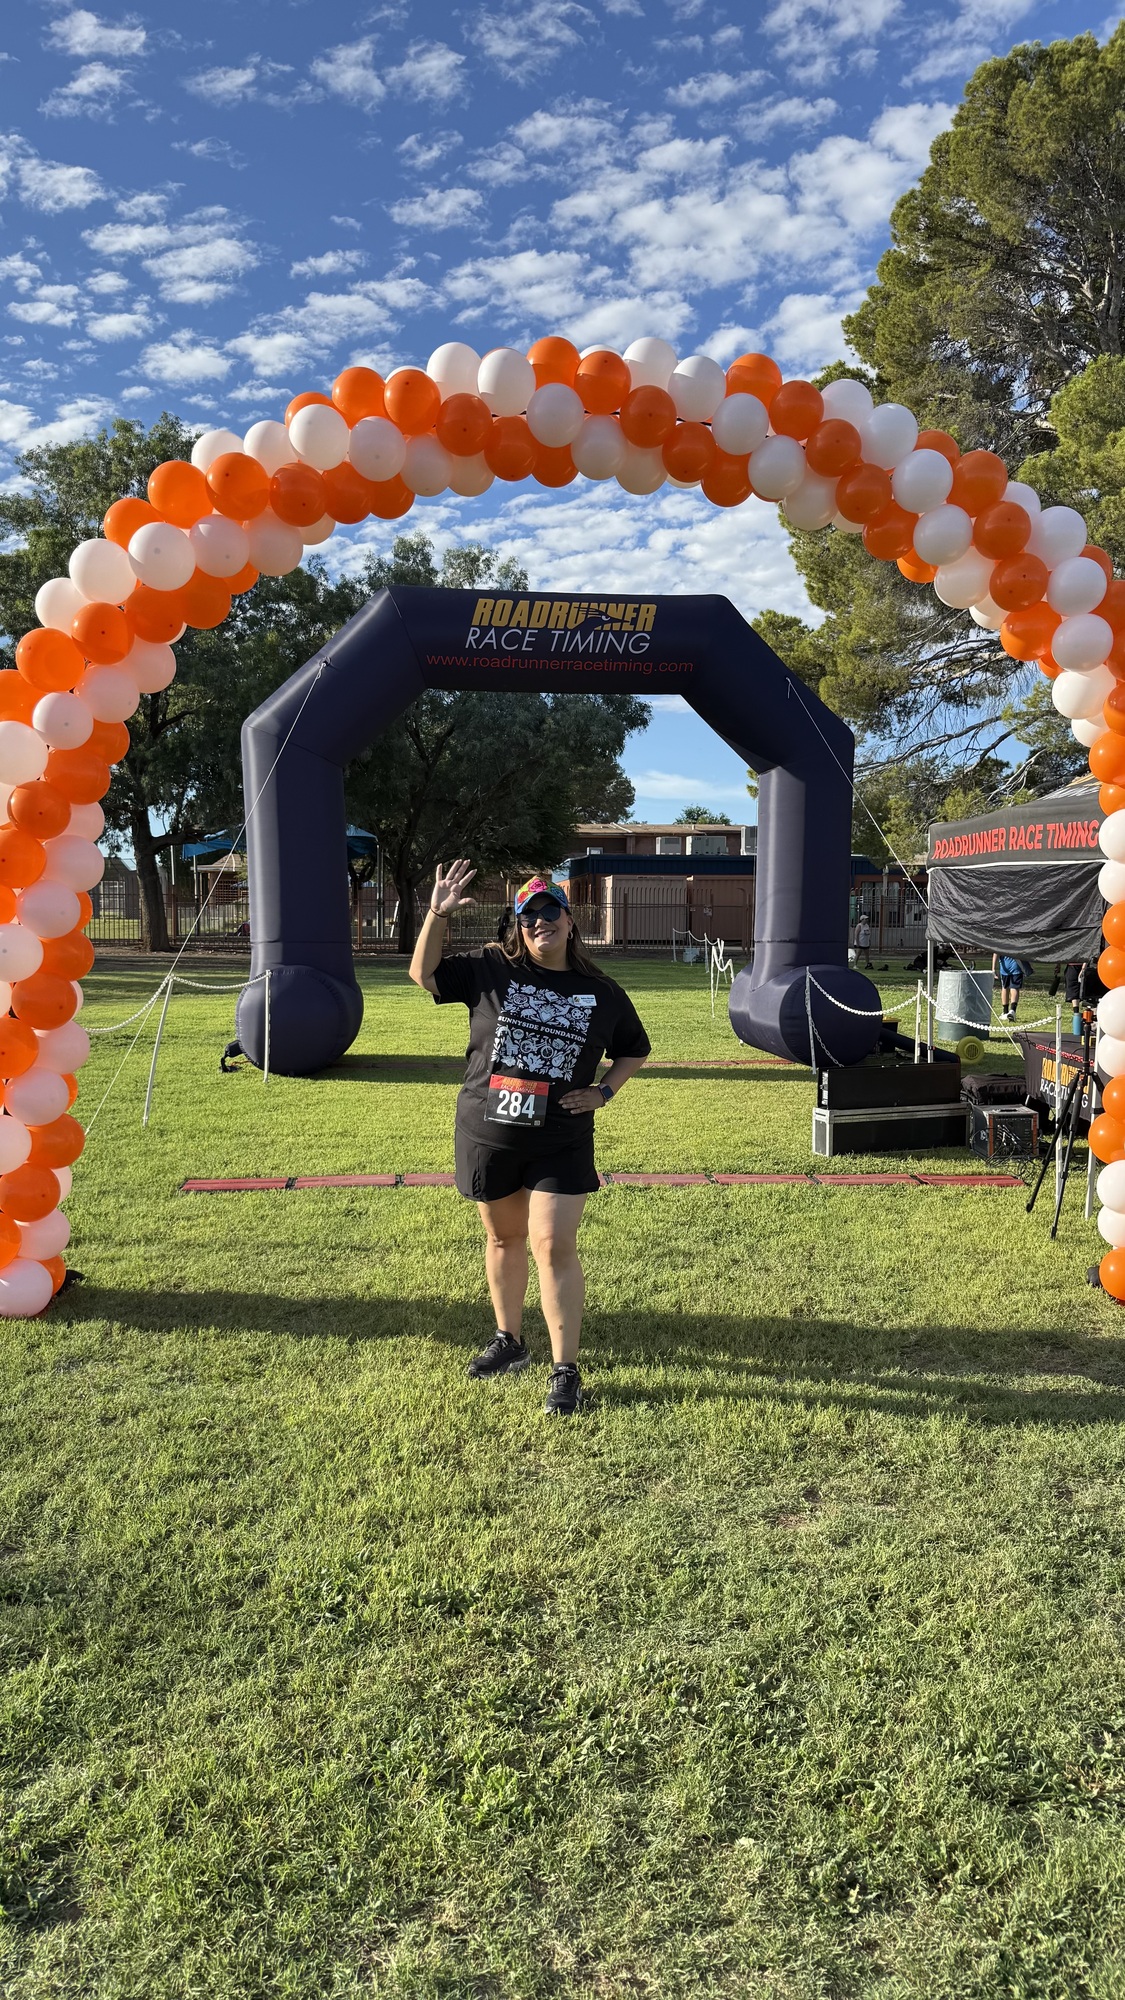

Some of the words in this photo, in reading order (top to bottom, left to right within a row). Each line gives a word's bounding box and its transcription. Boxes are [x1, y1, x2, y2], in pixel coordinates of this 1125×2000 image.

[471, 598, 657, 631] ROADRUNNER
[465, 627, 538, 651] RACE
[550, 631, 650, 654] TIMING
[426, 654, 694, 675] www.roadrunnerracetiming.com
[931, 826, 1006, 860] ROADRUNNER
[1009, 824, 1043, 850] RACE
[1046, 819, 1100, 849] TIMING
[497, 1015, 540, 1031] SUNNYSIDE
[540, 1026, 587, 1043] FOUNDATION
[496, 1089, 536, 1119] 284
